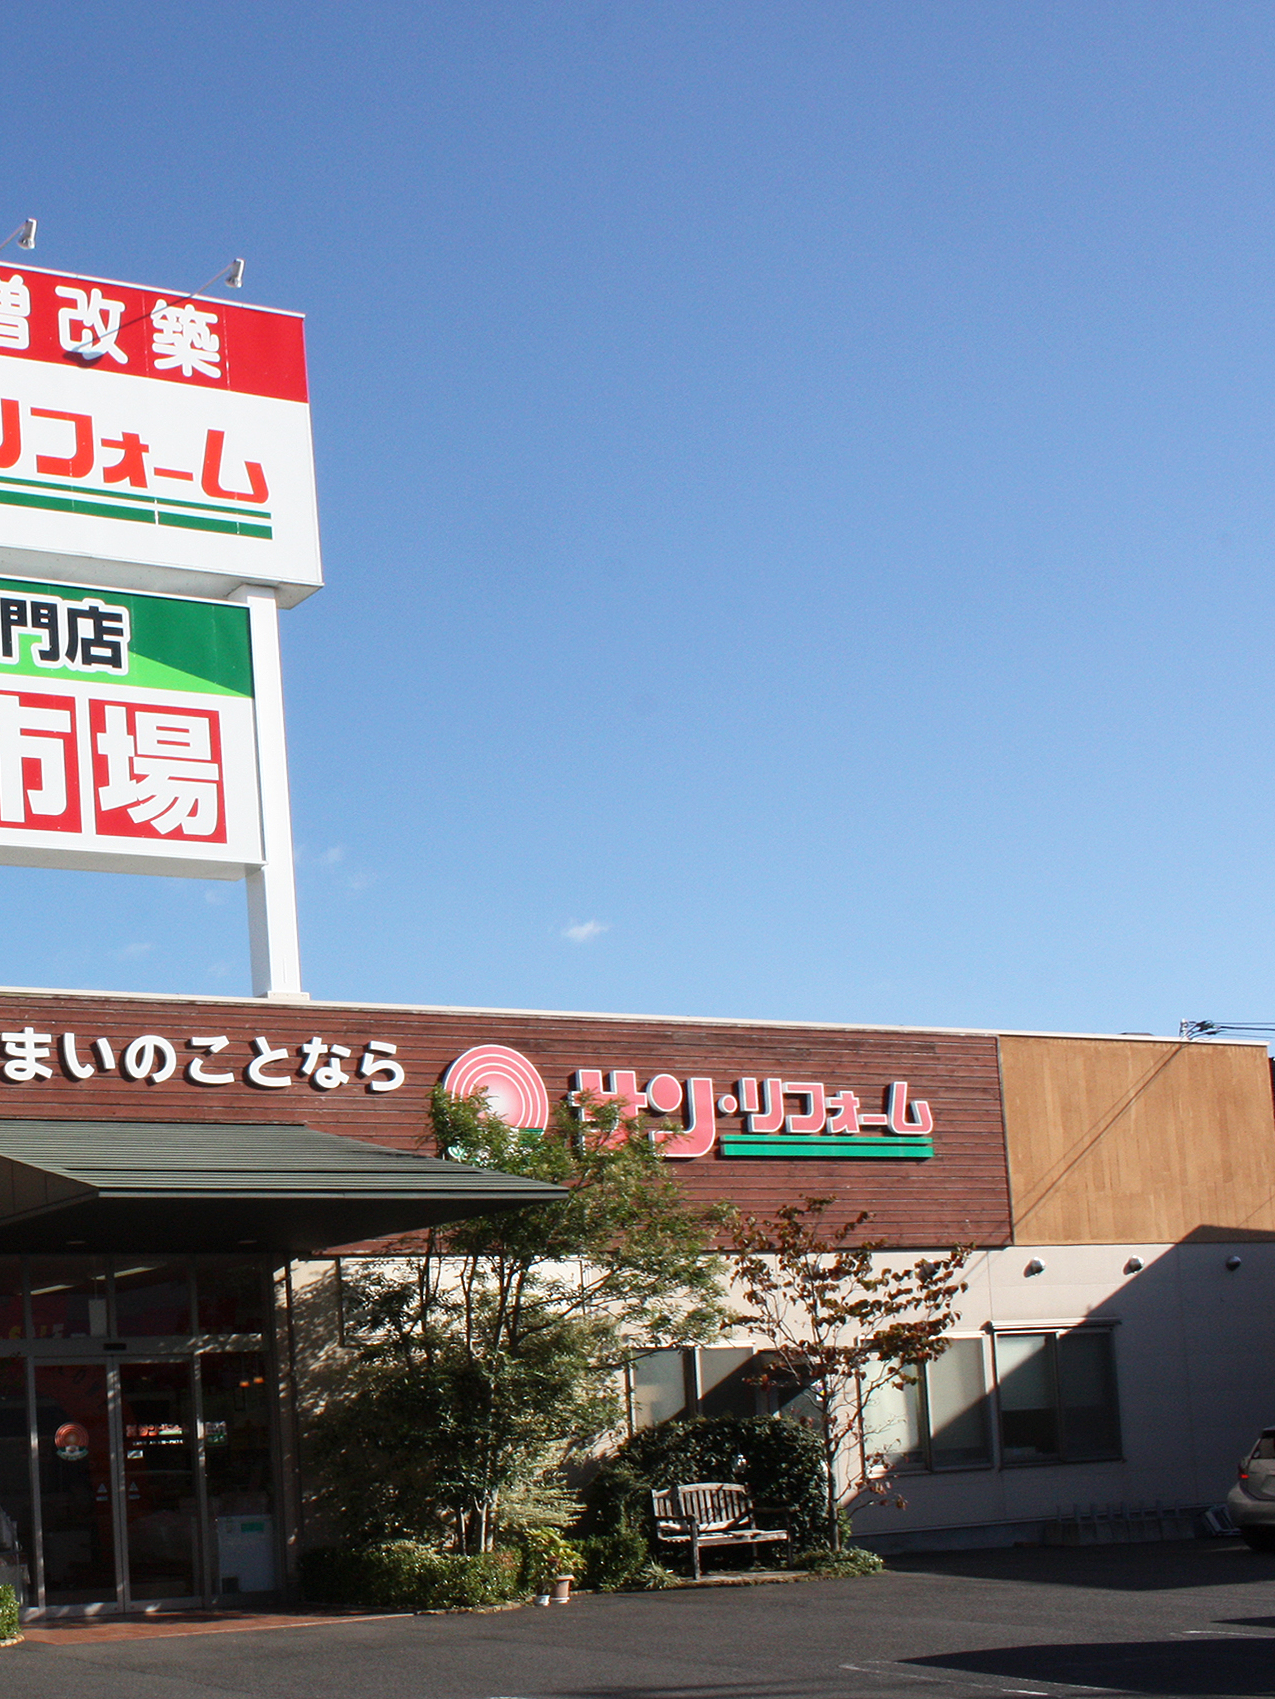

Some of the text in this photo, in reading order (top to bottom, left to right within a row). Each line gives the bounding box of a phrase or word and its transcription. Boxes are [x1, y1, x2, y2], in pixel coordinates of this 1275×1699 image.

[570, 1068, 933, 1159] サン・リフォーム
